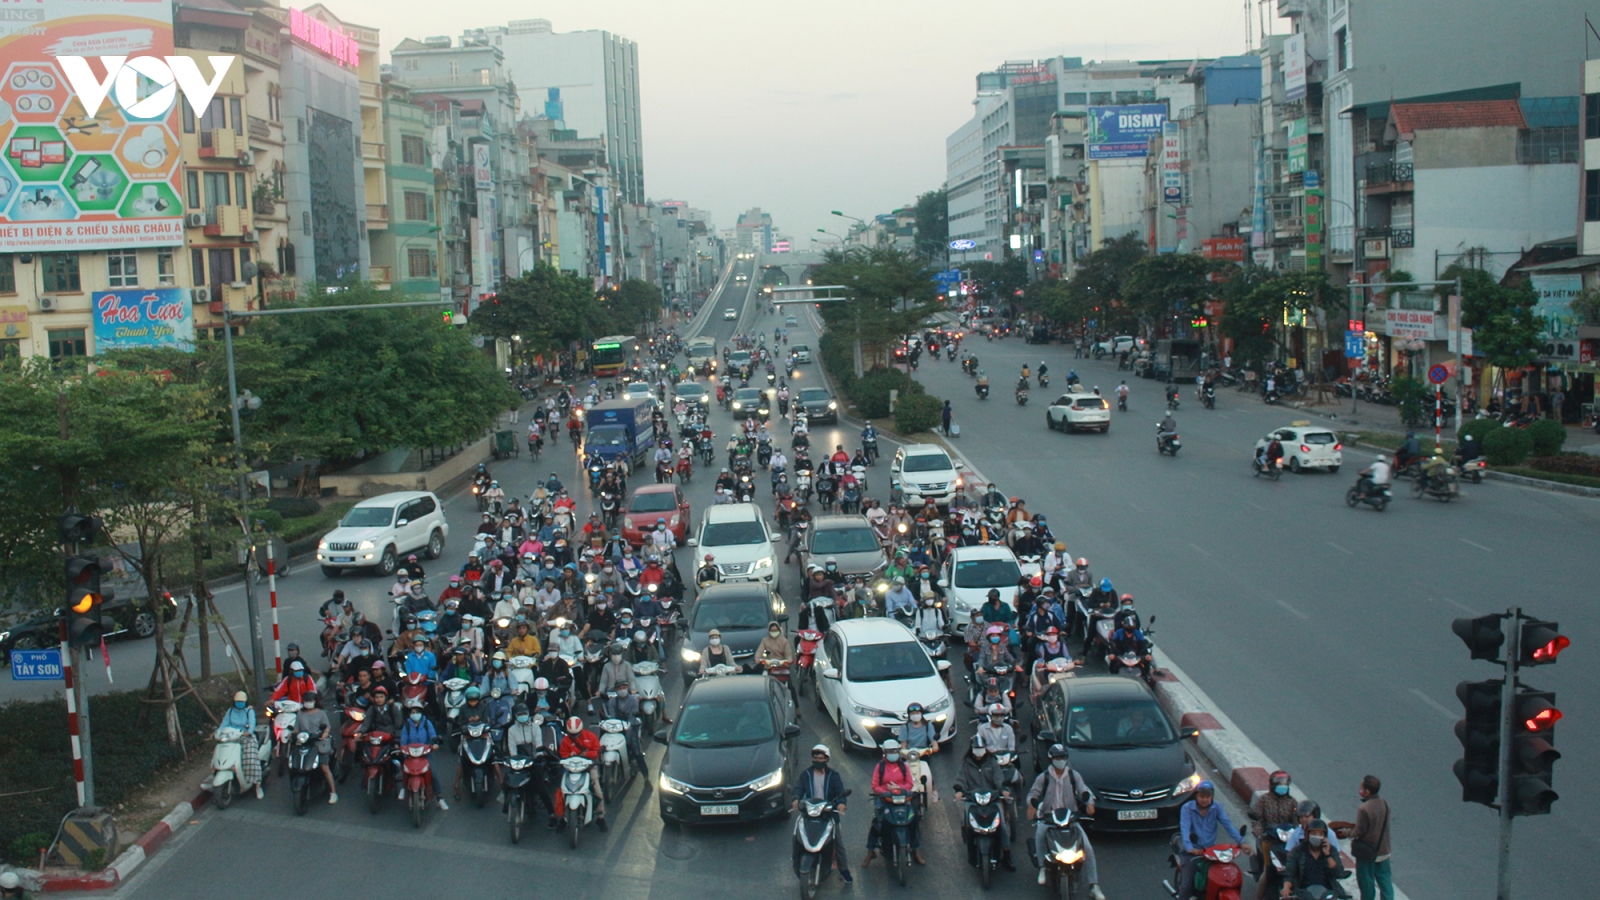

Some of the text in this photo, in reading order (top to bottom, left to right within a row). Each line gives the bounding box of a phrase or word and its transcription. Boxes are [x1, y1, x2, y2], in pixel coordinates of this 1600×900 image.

[102, 36, 127, 44] LIGHTING
[1118, 114, 1162, 128] DISMY
[23, 228, 34, 239] BỊ
[37, 225, 62, 238] ĐIỆN
[66, 227, 73, 236] &
[77, 223, 108, 236] CHIẾU
[112, 223, 140, 235] SÁNG
[144, 221, 171, 233] CHÂU
[175, 221, 182, 232] Á
[953, 241, 974, 249] Ford
[1543, 290, 1551, 299] DA
[1553, 288, 1566, 299] VIỆT
[98, 292, 184, 324] Hoa Tươi
[1397, 311, 1408, 323] THUÊ
[1420, 312, 1433, 324] HÀNG
[115, 327, 148, 338] Thanh
[1581, 353, 1592, 361] DA
[31, 652, 47, 661] PHỐ
[16, 662, 59, 675] TÂY SƠN
